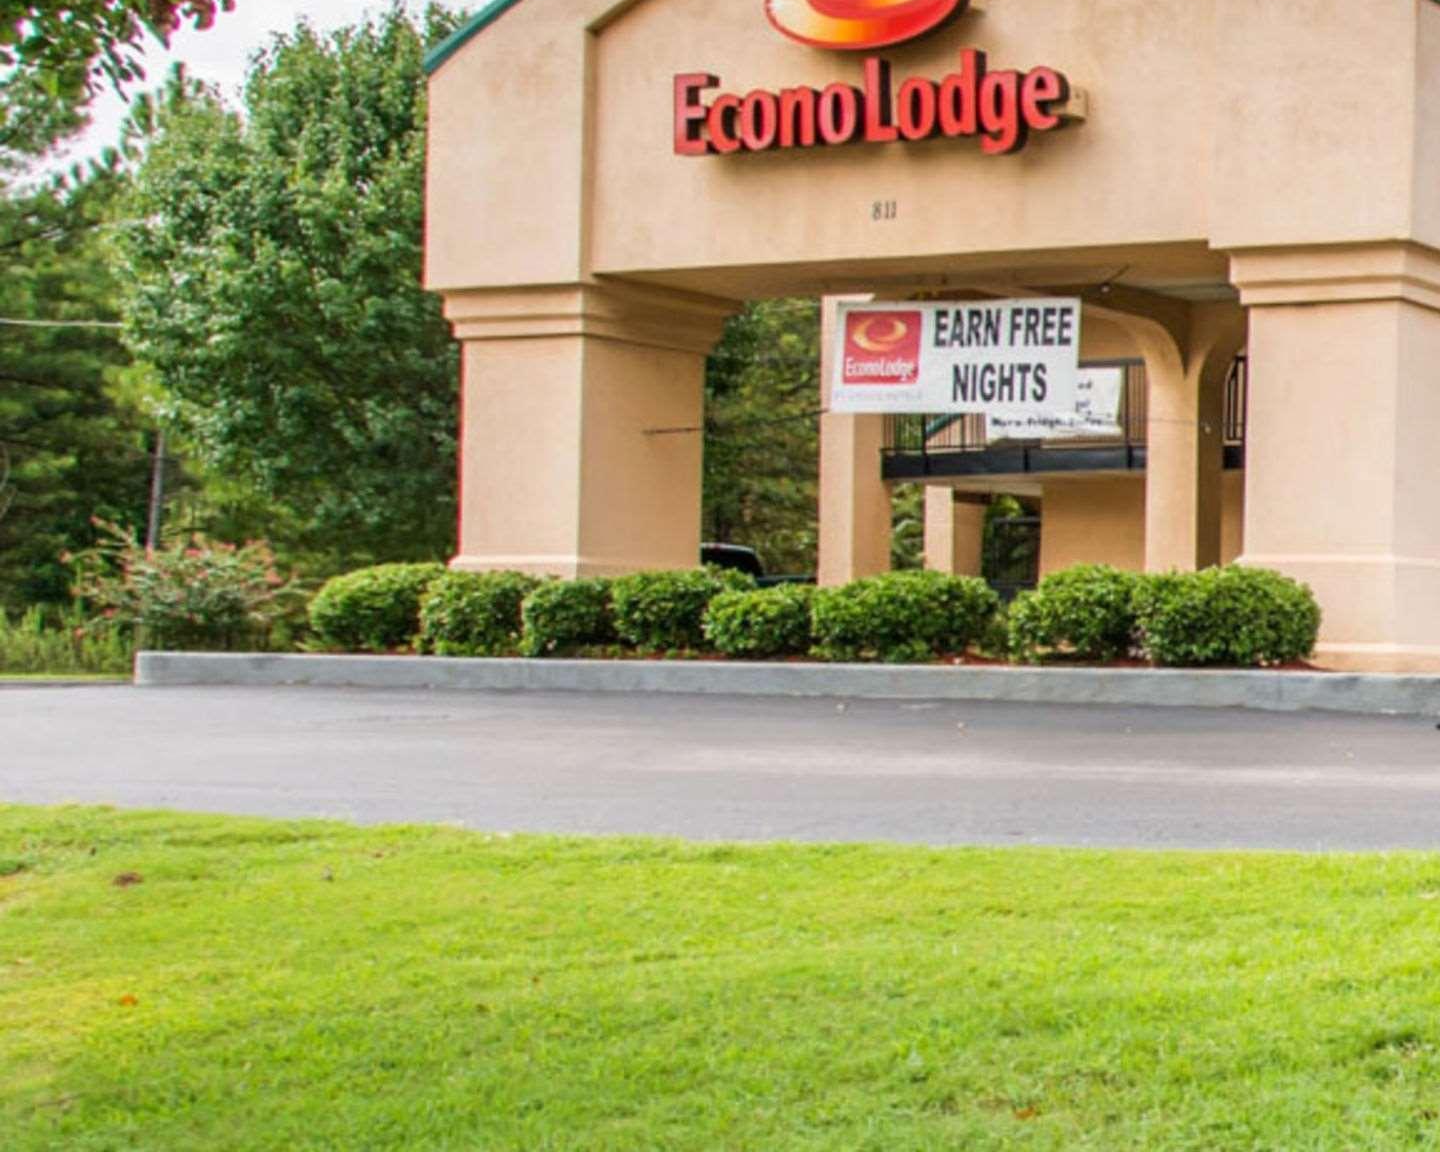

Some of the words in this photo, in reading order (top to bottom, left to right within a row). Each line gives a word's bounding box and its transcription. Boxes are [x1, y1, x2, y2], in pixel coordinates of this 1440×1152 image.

[673, 48, 1070, 156] EconoLodge
[872, 200, 897, 222] 811
[933, 309, 1000, 347] EARN
[1009, 307, 1073, 346] FREE
[952, 363, 1047, 402] NIGHTS
